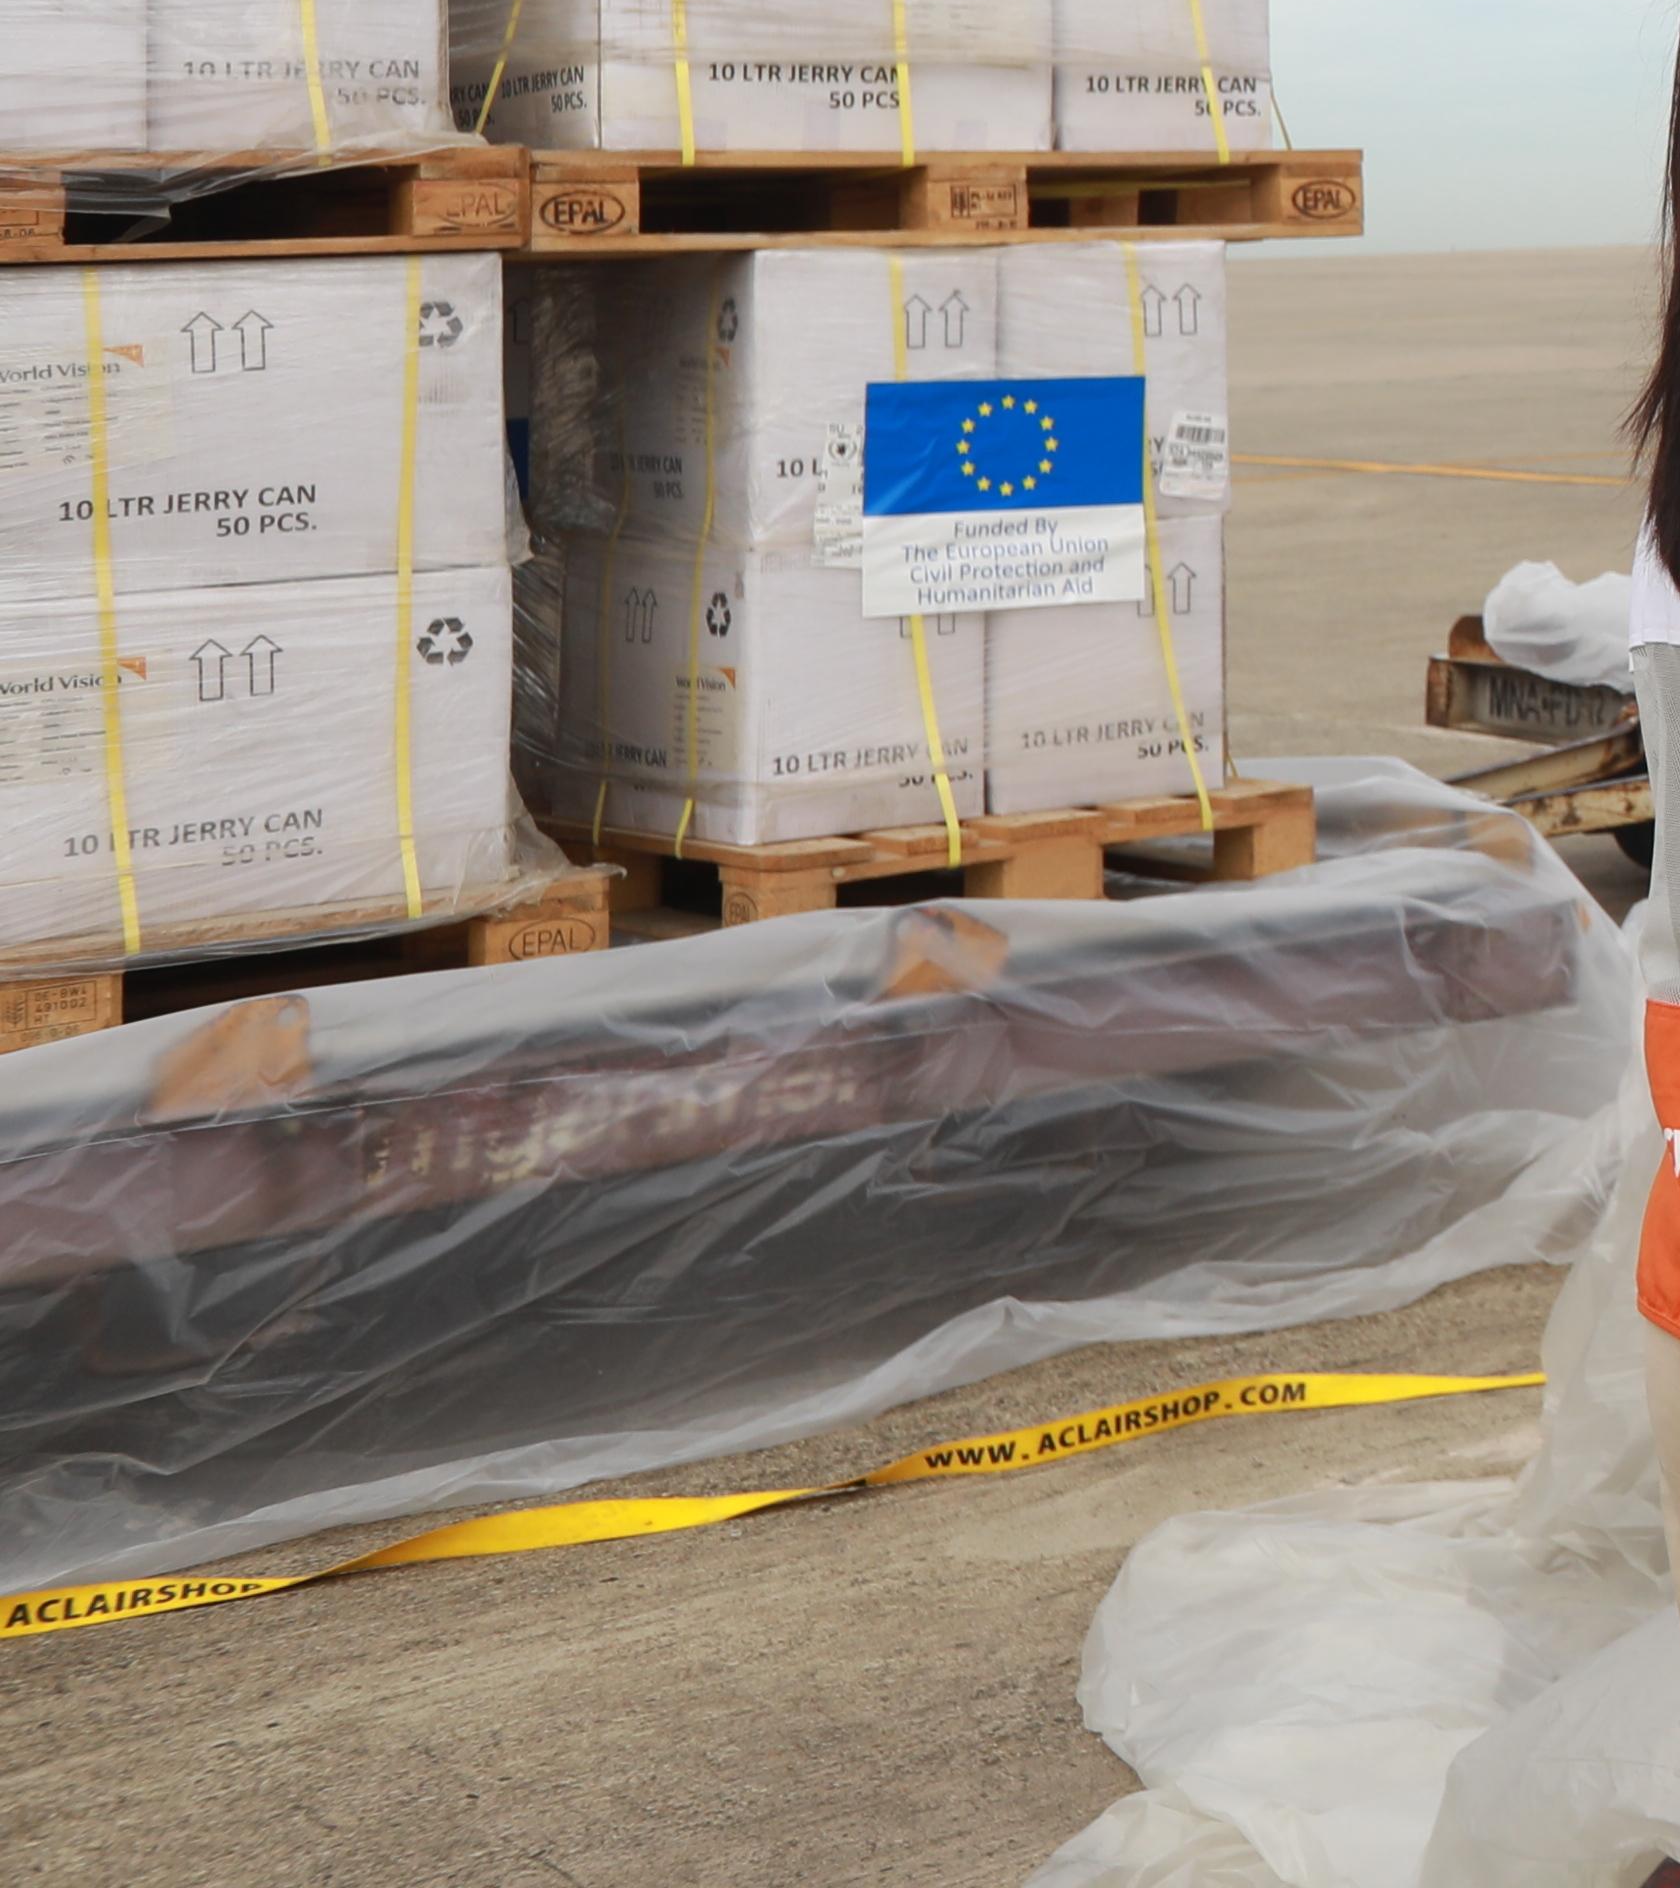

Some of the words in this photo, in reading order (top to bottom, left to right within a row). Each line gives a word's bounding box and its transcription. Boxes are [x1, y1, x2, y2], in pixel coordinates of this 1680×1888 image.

[709, 63, 736, 82] 10
[743, 63, 782, 83] LTR
[787, 64, 854, 84] JERRY
[1086, 74, 1109, 93] 10
[1114, 75, 1150, 94] LTR
[1155, 76, 1213, 95] JERRY
[1217, 77, 1257, 95] CAN
[551, 95, 563, 113] 50
[564, 93, 587, 110] PCS.
[553, 199, 609, 226] EPAL
[1301, 189, 1342, 211] EPAL
[776, 458, 804, 479] 10
[58, 499, 94, 522] 10
[102, 494, 154, 518] LTR
[163, 489, 249, 515] JERRY
[258, 484, 317, 508] CAN
[216, 516, 250, 538] 50
[259, 512, 318, 534] PCS.
[953, 519, 1029, 540] Funded
[1035, 516, 1059, 538] By
[902, 544, 939, 564] The
[945, 539, 1044, 562] European
[1049, 536, 1110, 555] Union
[909, 565, 953, 586] Civil
[959, 560, 1064, 582] Protection
[1068, 555, 1105, 575] and
[917, 580, 1056, 606] Humanitarian
[1062, 577, 1095, 596] Aid
[520, 928, 582, 955] EPAL
